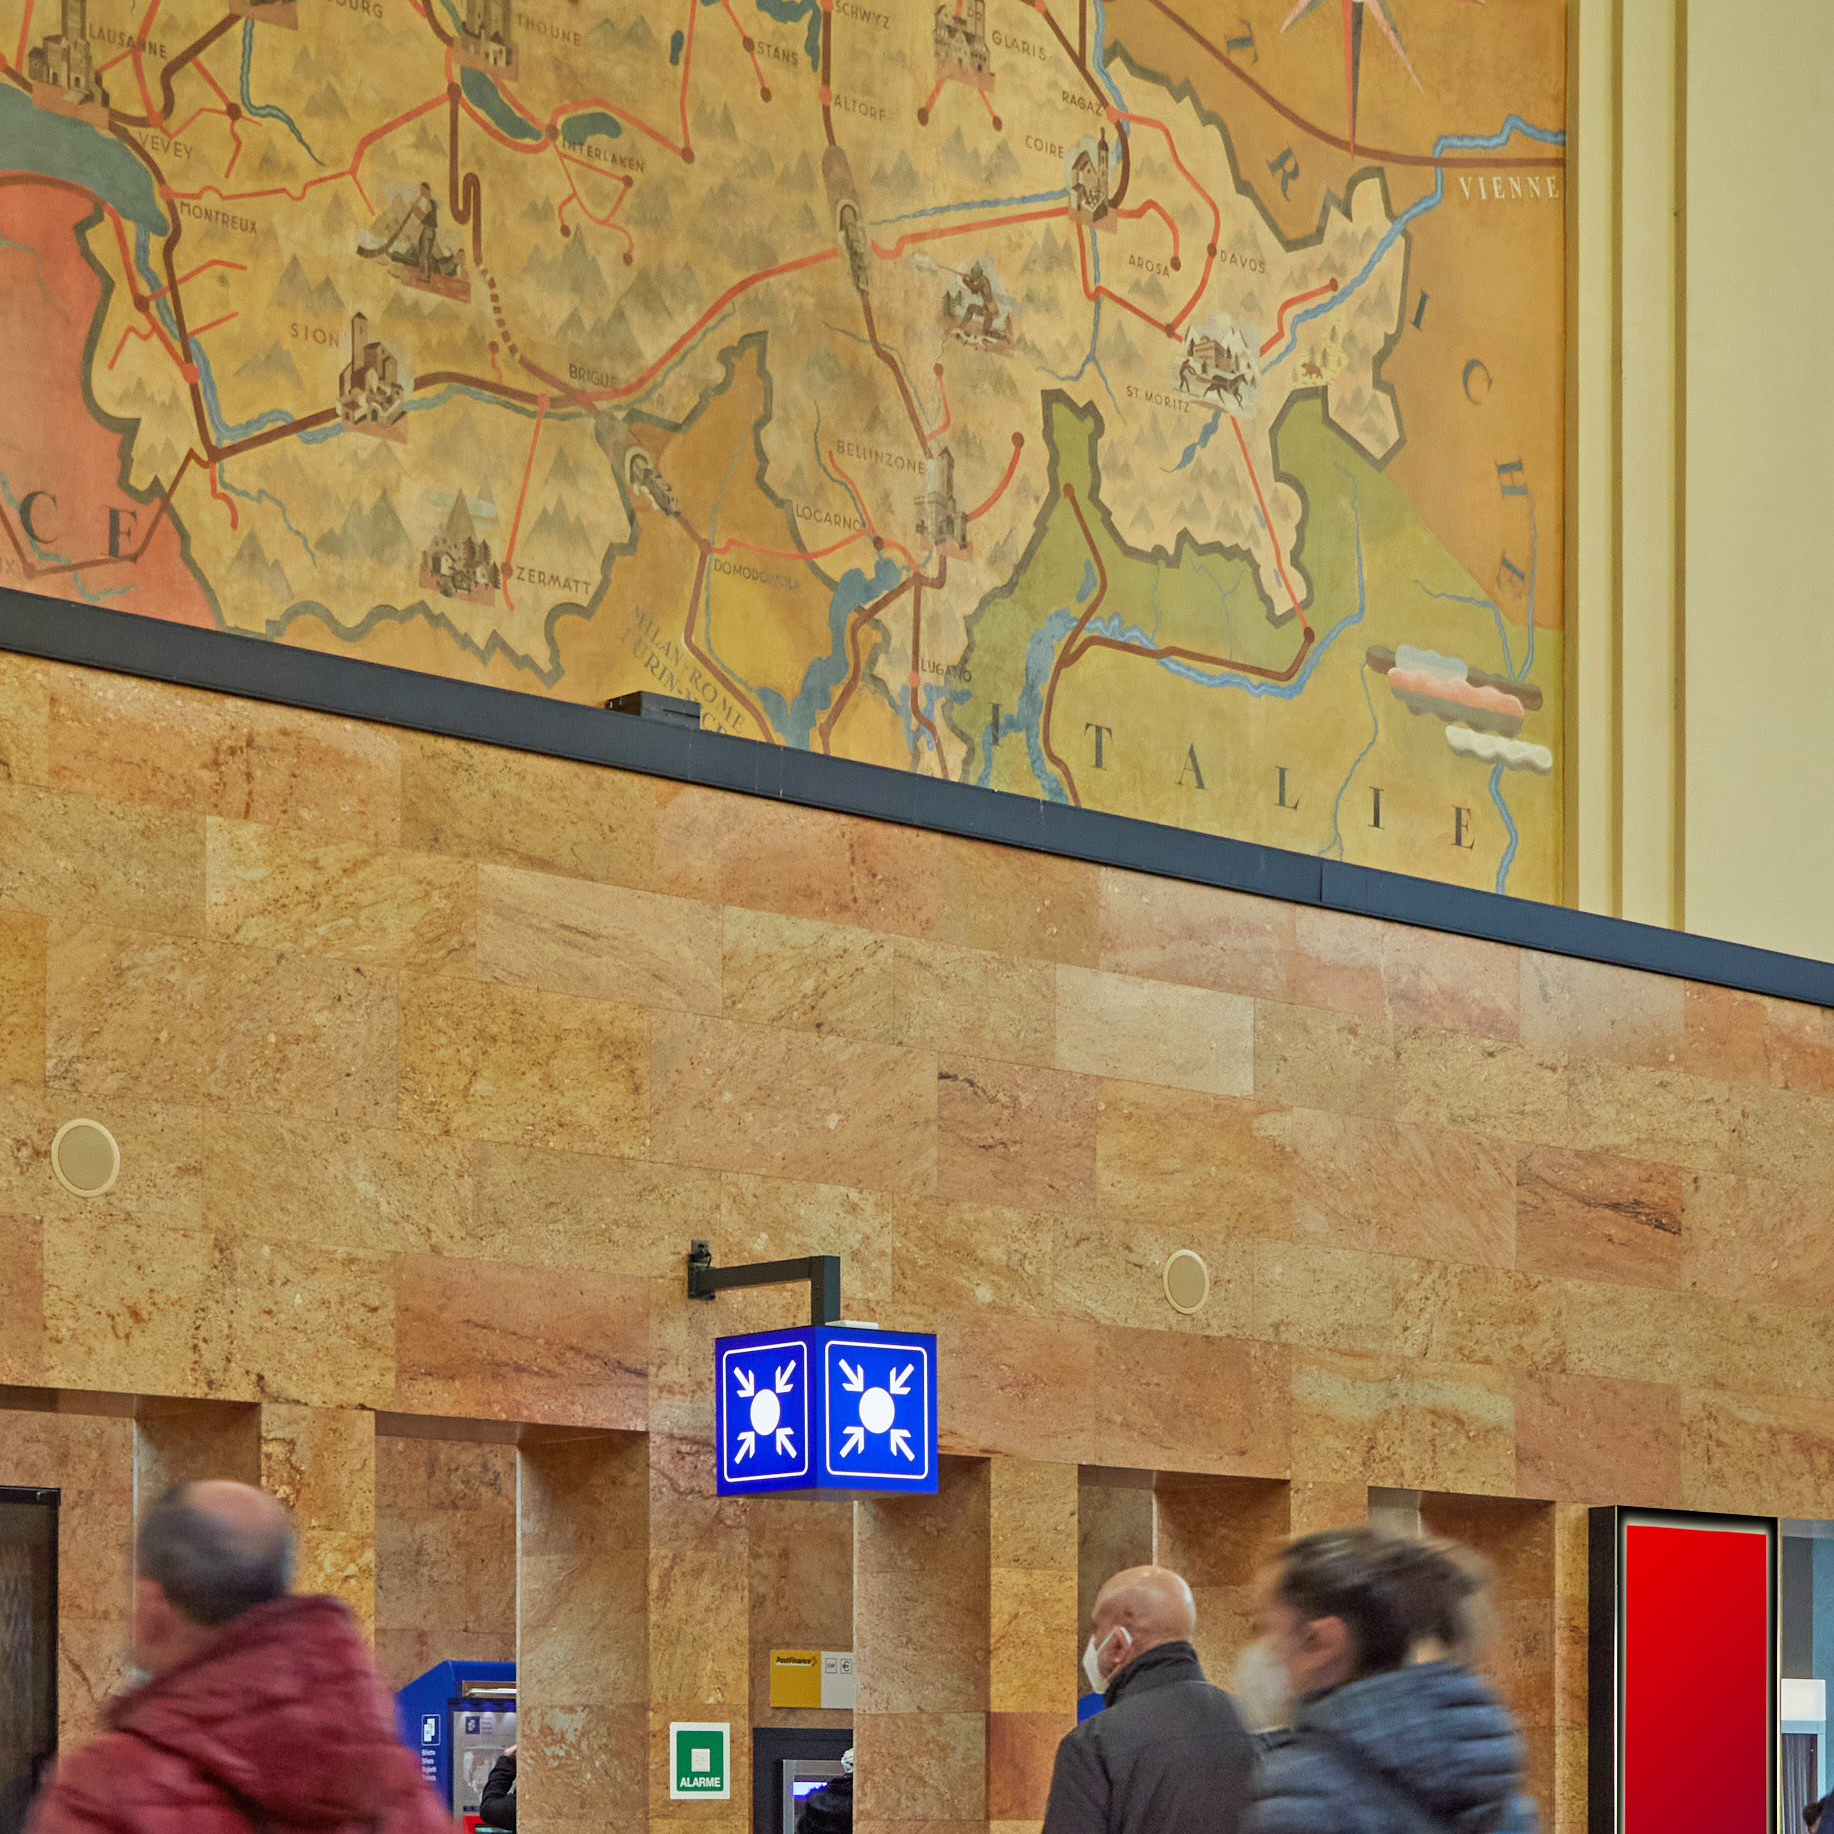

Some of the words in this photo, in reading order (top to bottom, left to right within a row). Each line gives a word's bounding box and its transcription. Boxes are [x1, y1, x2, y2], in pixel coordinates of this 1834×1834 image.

[835, 0, 891, 31] SCHWYZ
[88, 23, 168, 60] LAUSANNE
[517, 13, 582, 48] THOUNE
[757, 41, 799, 66] STANS
[992, 30, 1047, 62] GLARIS
[834, 95, 887, 122] ALTORF
[1061, 89, 1103, 117] RAGAZ
[138, 131, 194, 160] VEVEY
[562, 140, 645, 173] INTERLAKEN
[1025, 134, 1065, 160] COIRE
[1458, 175, 1560, 200] VIENNE
[179, 201, 258, 235] MONTREUX
[1128, 253, 1170, 278] AROSA
[1220, 249, 1266, 275] DAVOS
[290, 322, 340, 348] SION
[568, 363, 618, 388] BRIGUE
[1145, 390, 1191, 414] MORITZ
[836, 439, 926, 476] BELLINZONE
[795, 503, 864, 532] LOCARNO
[516, 565, 592, 597] ZERMATT
[921, 657, 973, 684] LUGANO
[990, 701, 1476, 851] ITALIE
[775, 1655, 812, 1666] PostFinance
[679, 1776, 721, 1788] ALARME
